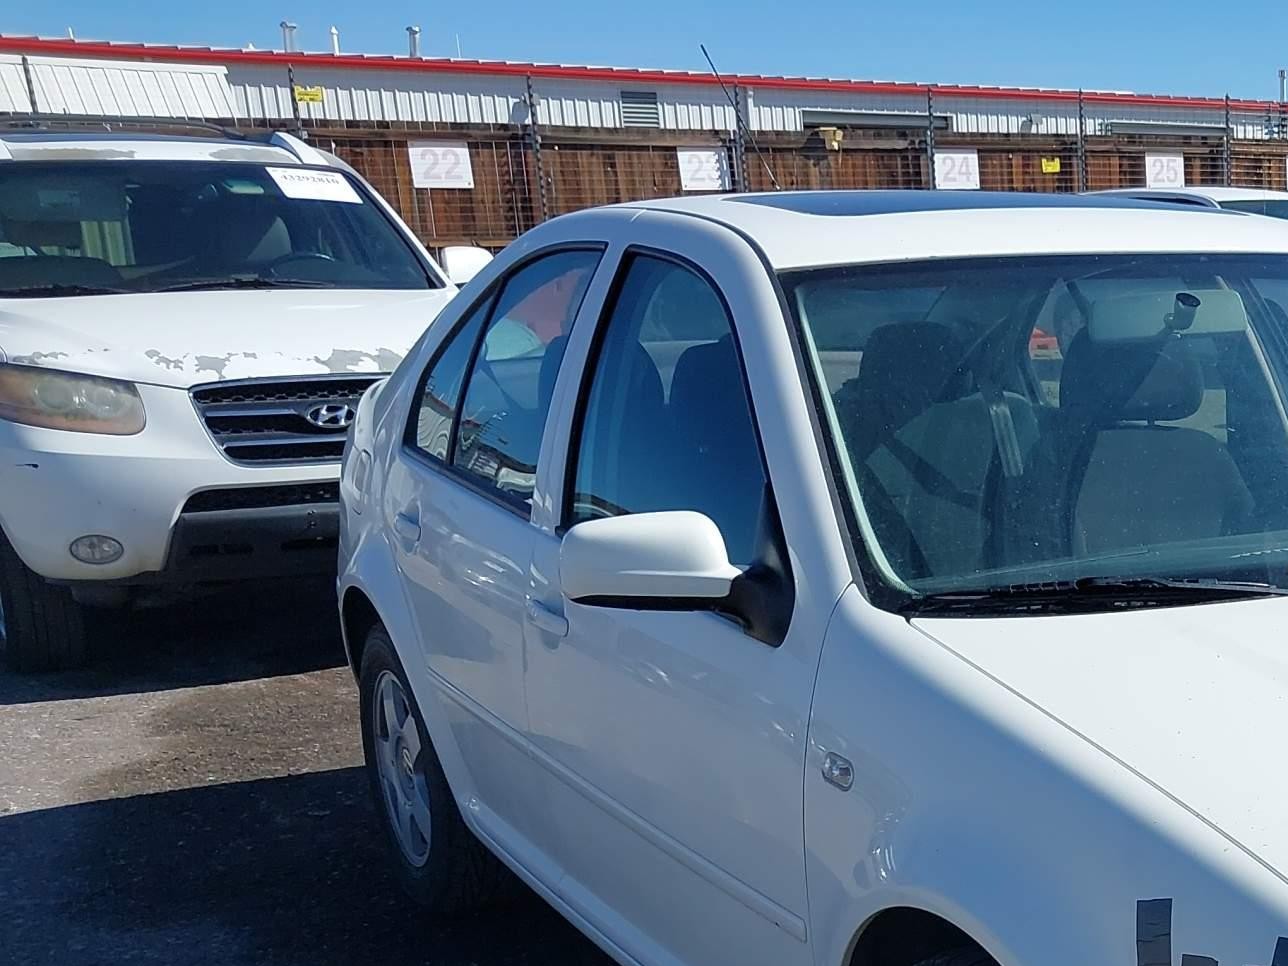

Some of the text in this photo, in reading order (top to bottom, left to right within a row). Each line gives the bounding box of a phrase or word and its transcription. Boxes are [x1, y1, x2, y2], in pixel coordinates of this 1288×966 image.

[419, 149, 463, 180] 22
[942, 155, 972, 183] 24
[1152, 158, 1178, 183] 25
